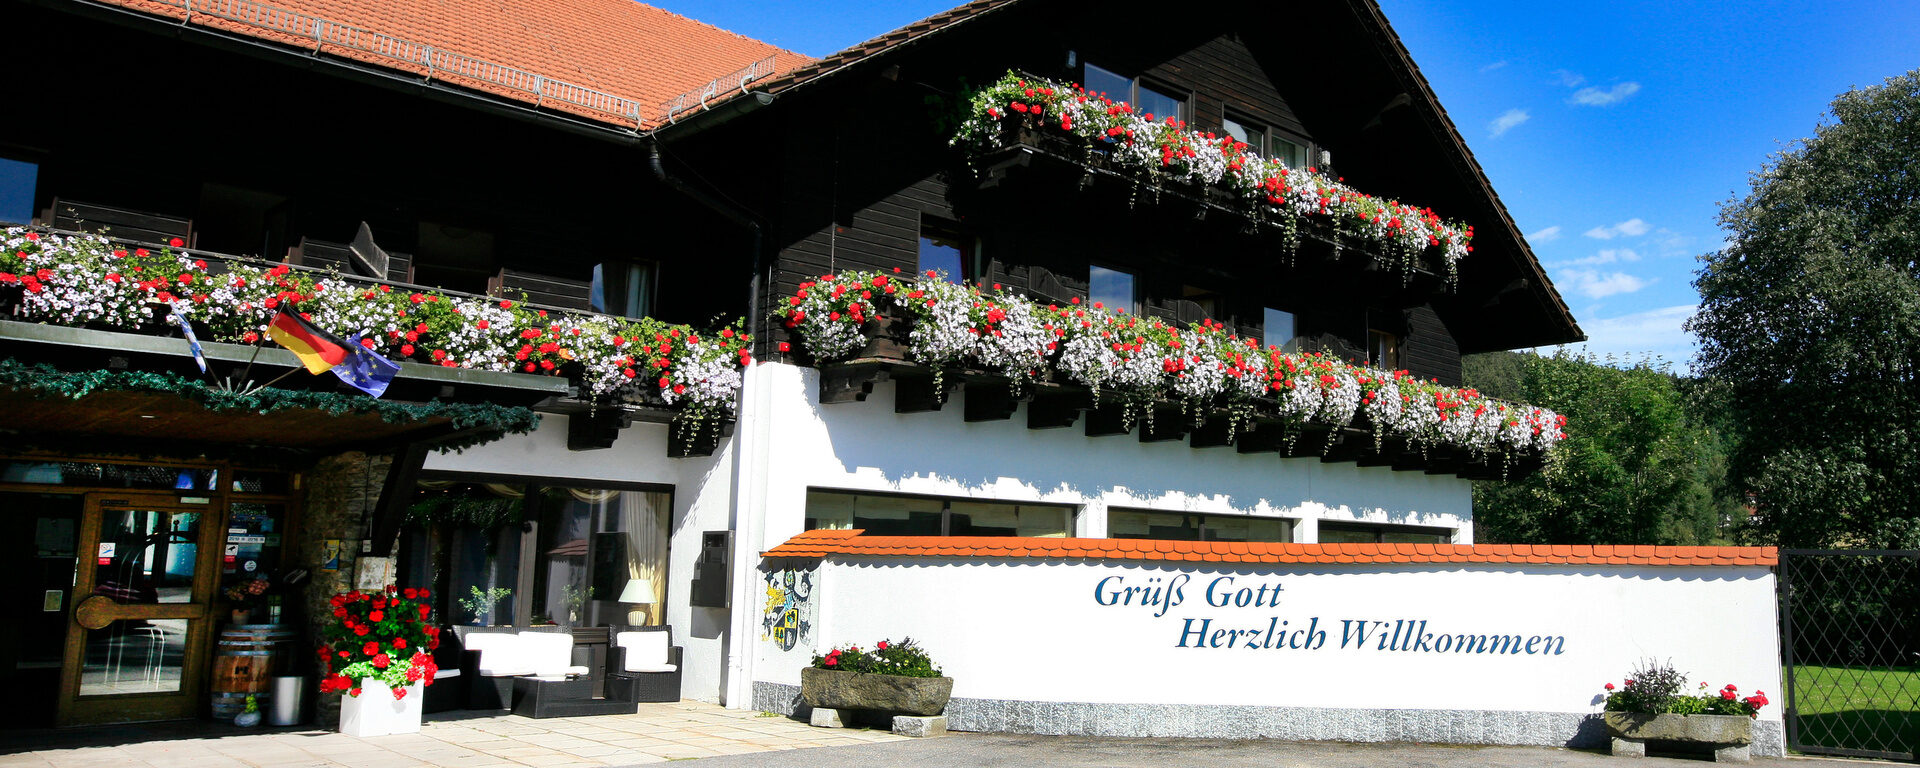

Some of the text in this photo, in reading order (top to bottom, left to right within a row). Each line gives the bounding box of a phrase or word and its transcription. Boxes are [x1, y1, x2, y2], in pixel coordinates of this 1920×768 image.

[1094, 574, 1285, 618] Grüß Gott
[1175, 617, 1567, 656] Herzlich Willkommen
